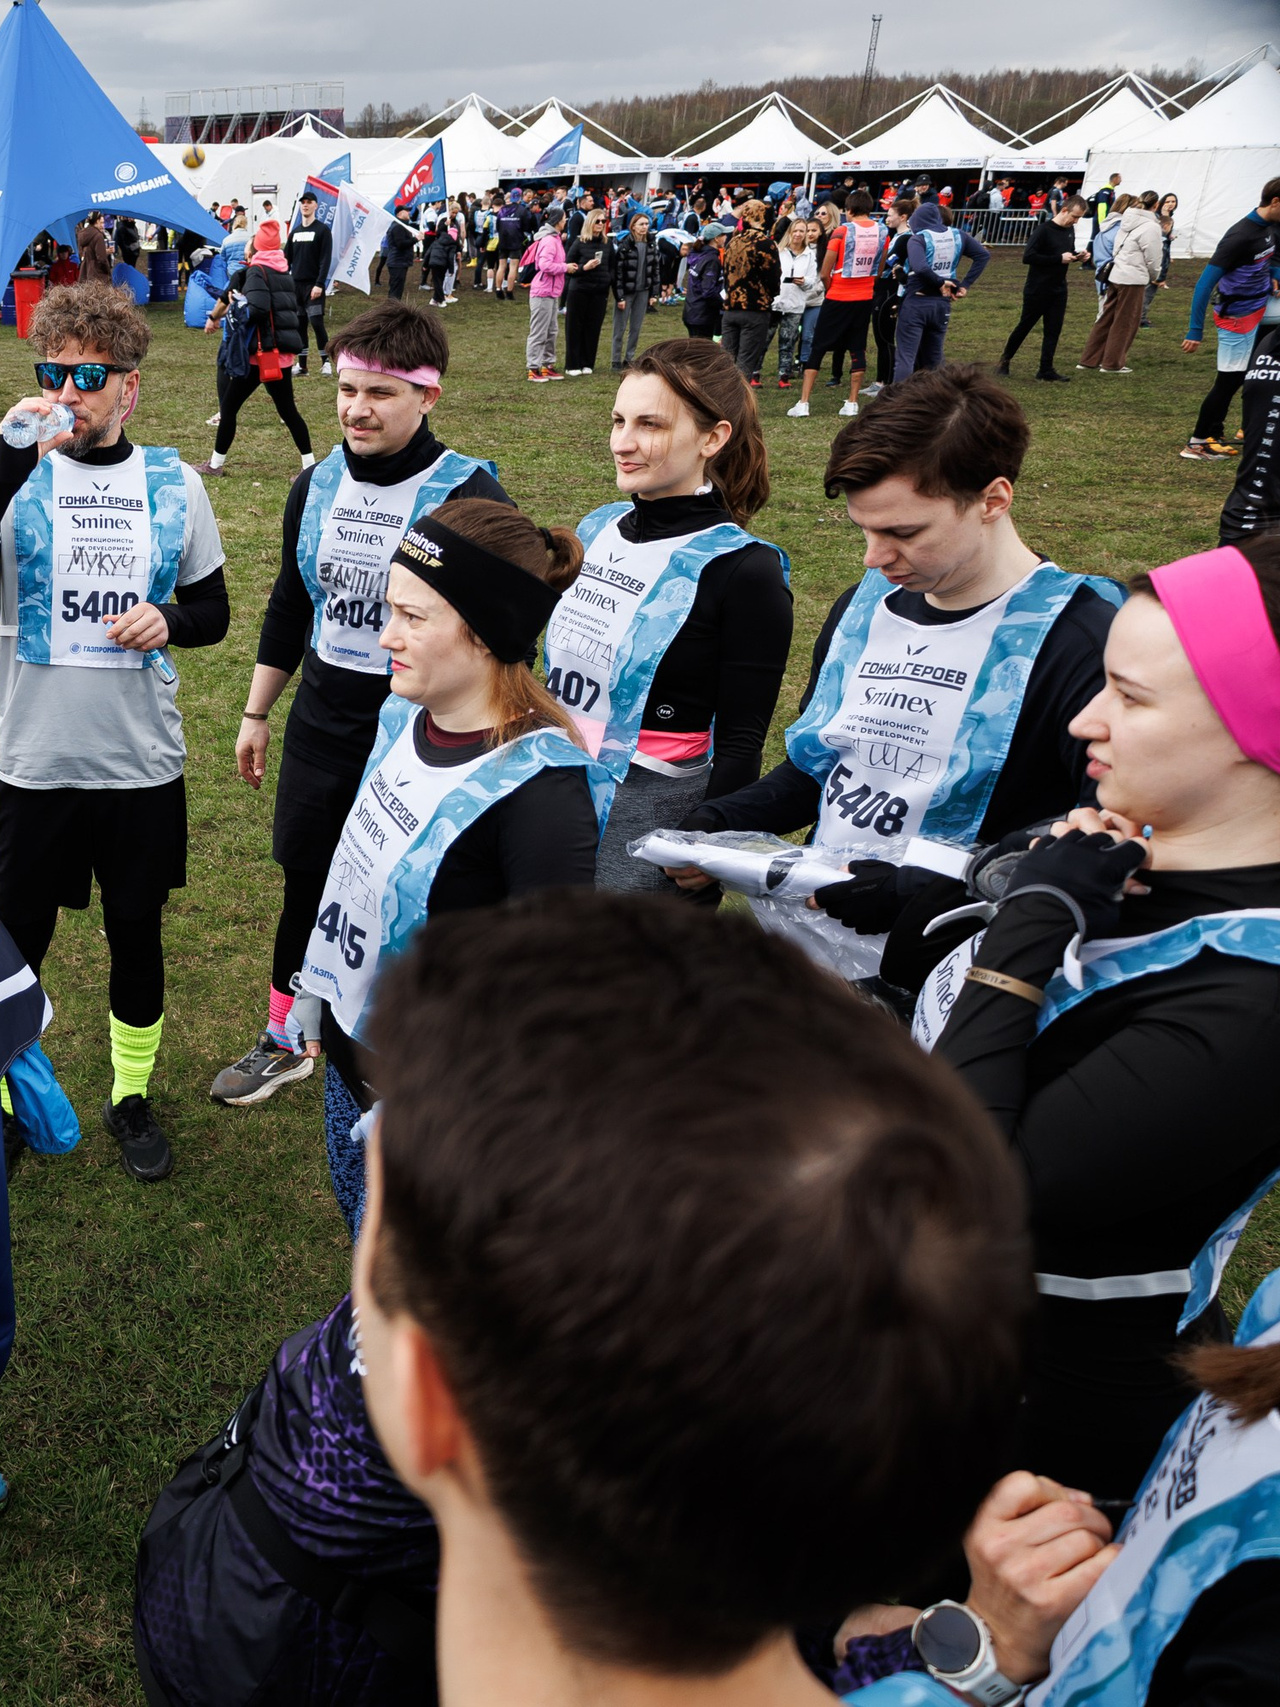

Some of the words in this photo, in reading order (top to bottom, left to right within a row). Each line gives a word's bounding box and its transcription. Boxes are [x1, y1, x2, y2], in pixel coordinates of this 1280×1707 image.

[91, 174, 172, 204] ГАЗПРОМБАНК
[856, 256, 873, 266] 5010
[932, 261, 951, 270] 5013
[58, 496, 98, 506] ГОНКА
[101, 496, 144, 508] ГЕРОЕВ
[72, 514, 132, 531] Sminex
[332, 507, 363, 520] ГОНКА
[365, 510, 404, 526] ГЕРОЕВ
[335, 526, 386, 547] Sminex
[404, 528, 443, 558] Sminex
[331, 548, 382, 560] ПЕРФЕКЦИОНИСТЫ
[342, 558, 380, 568] DEVELOPMENT
[401, 541, 429, 564] team
[604, 568, 646, 592] ГЕРОЕВ
[570, 582, 620, 614] Sminex
[326, 592, 384, 632] 5404
[562, 605, 610, 629] ПЕРФЕКЦИОНИСТЫ
[568, 618, 606, 637] DEVELOPMENT
[332, 646, 370, 659] ГАЗПРОМБАНК
[860, 661, 900, 675] ГОНКА
[902, 662, 968, 686] ГЕРОЕВ
[860, 686, 938, 716] Sminex
[847, 714, 930, 736] ПЕРФЕКЦИОНИСТЫ
[860, 727, 926, 747] DEVELOPMENT
[373, 769, 389, 800] ГОНКА
[384, 792, 420, 832] ГЕРОЕВ
[827, 762, 910, 838] 5408
[354, 798, 390, 852] Sminex
[344, 844, 370, 878] DEVELOPMENT
[937, 952, 960, 1022] Sminex
